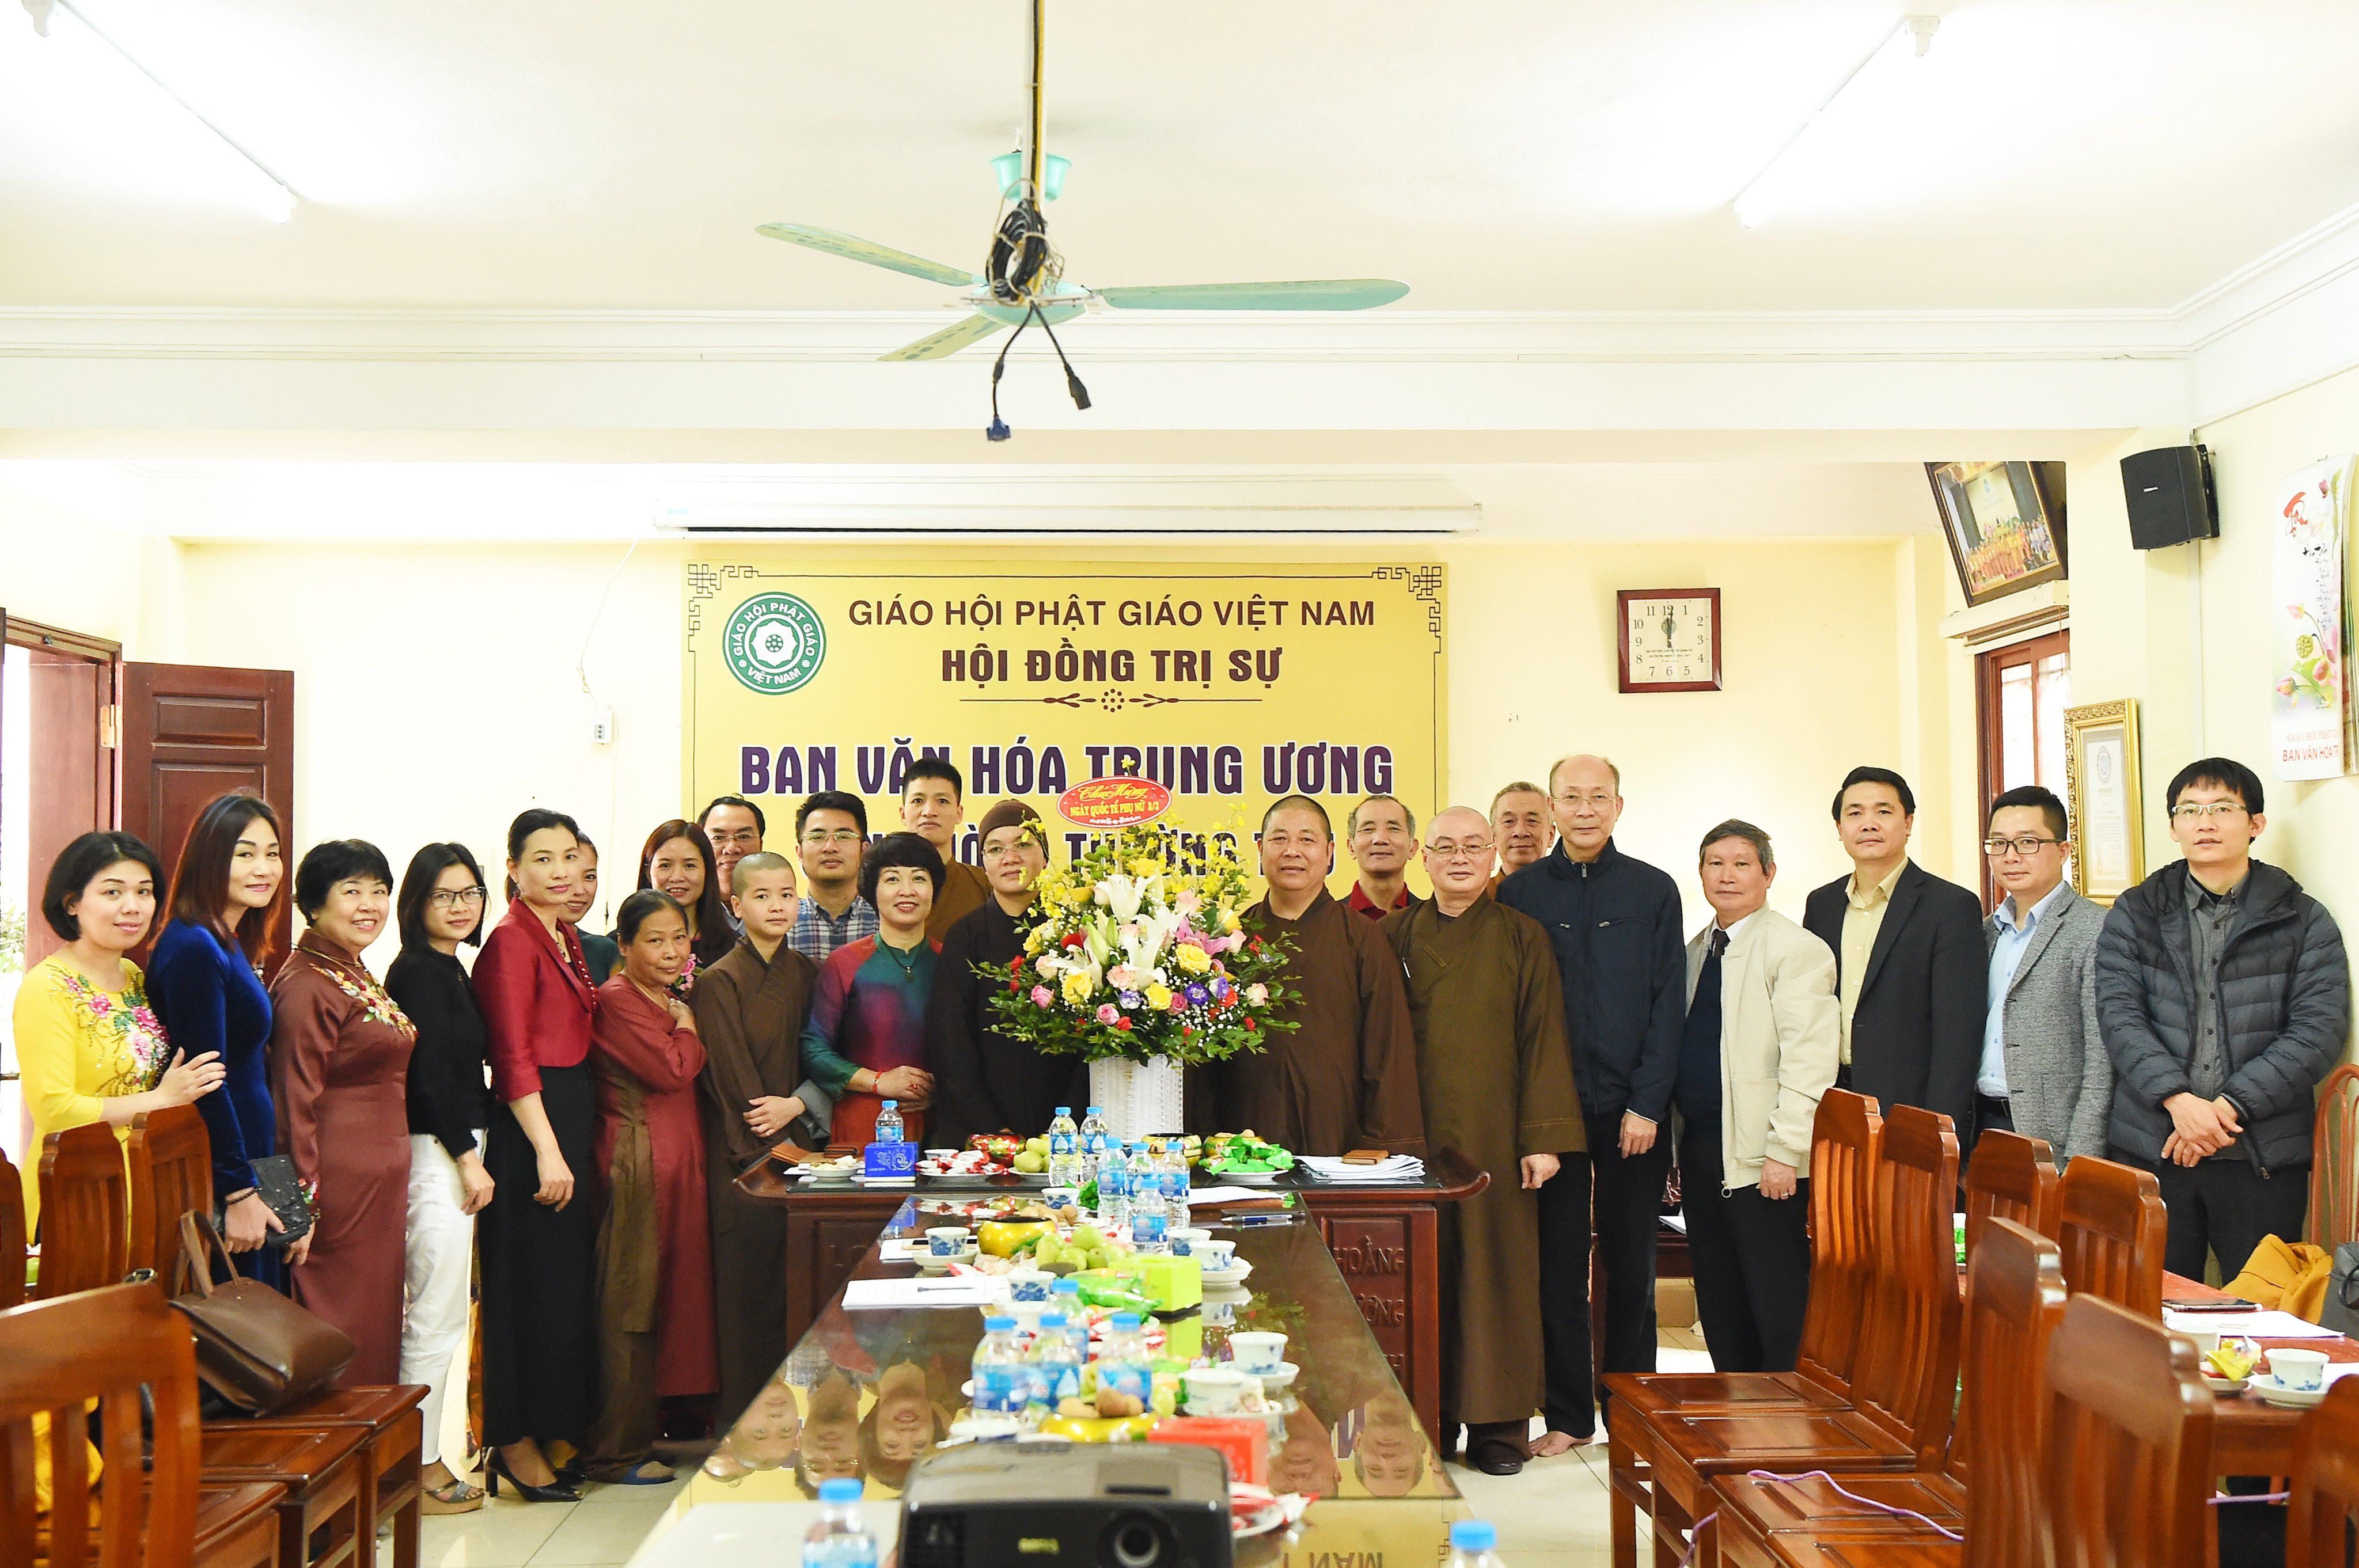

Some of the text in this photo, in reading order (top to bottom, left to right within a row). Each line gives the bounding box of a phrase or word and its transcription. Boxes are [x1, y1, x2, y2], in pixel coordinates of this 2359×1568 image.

[849, 593, 1374, 631] GIÁO HỘI PHẬT GIÁO VIỆT NAM
[1647, 606, 1656, 616] 11
[1663, 605, 1674, 616] 12
[1683, 605, 1688, 615] 1
[1633, 619, 1644, 629] 10
[1697, 616, 1704, 627] 2
[731, 602, 818, 656] GIÁO HỘI PHẬT GIÁO
[1636, 637, 1642, 647] 9
[1697, 635, 1704, 645] 3
[942, 637, 1283, 689] HỘI ĐỒNG TRỊ SỰ
[1636, 654, 1643, 664] 8
[1697, 654, 1704, 663] 4
[748, 666, 802, 684] VIỆT NAM
[1649, 666, 1655, 677] 7
[1666, 666, 1673, 676] 6
[1683, 666, 1690, 675] 5
[2283, 749, 2300, 762] BAN
[742, 746, 836, 794] BAN
[972, 736, 1067, 794] HÓA
[1263, 742, 1393, 795] ƯƠNG
[1078, 784, 1112, 802] Chúc
[1070, 799, 1159, 817] NGÀY QUỐC TẾ PHỤ NỮ 8/3
